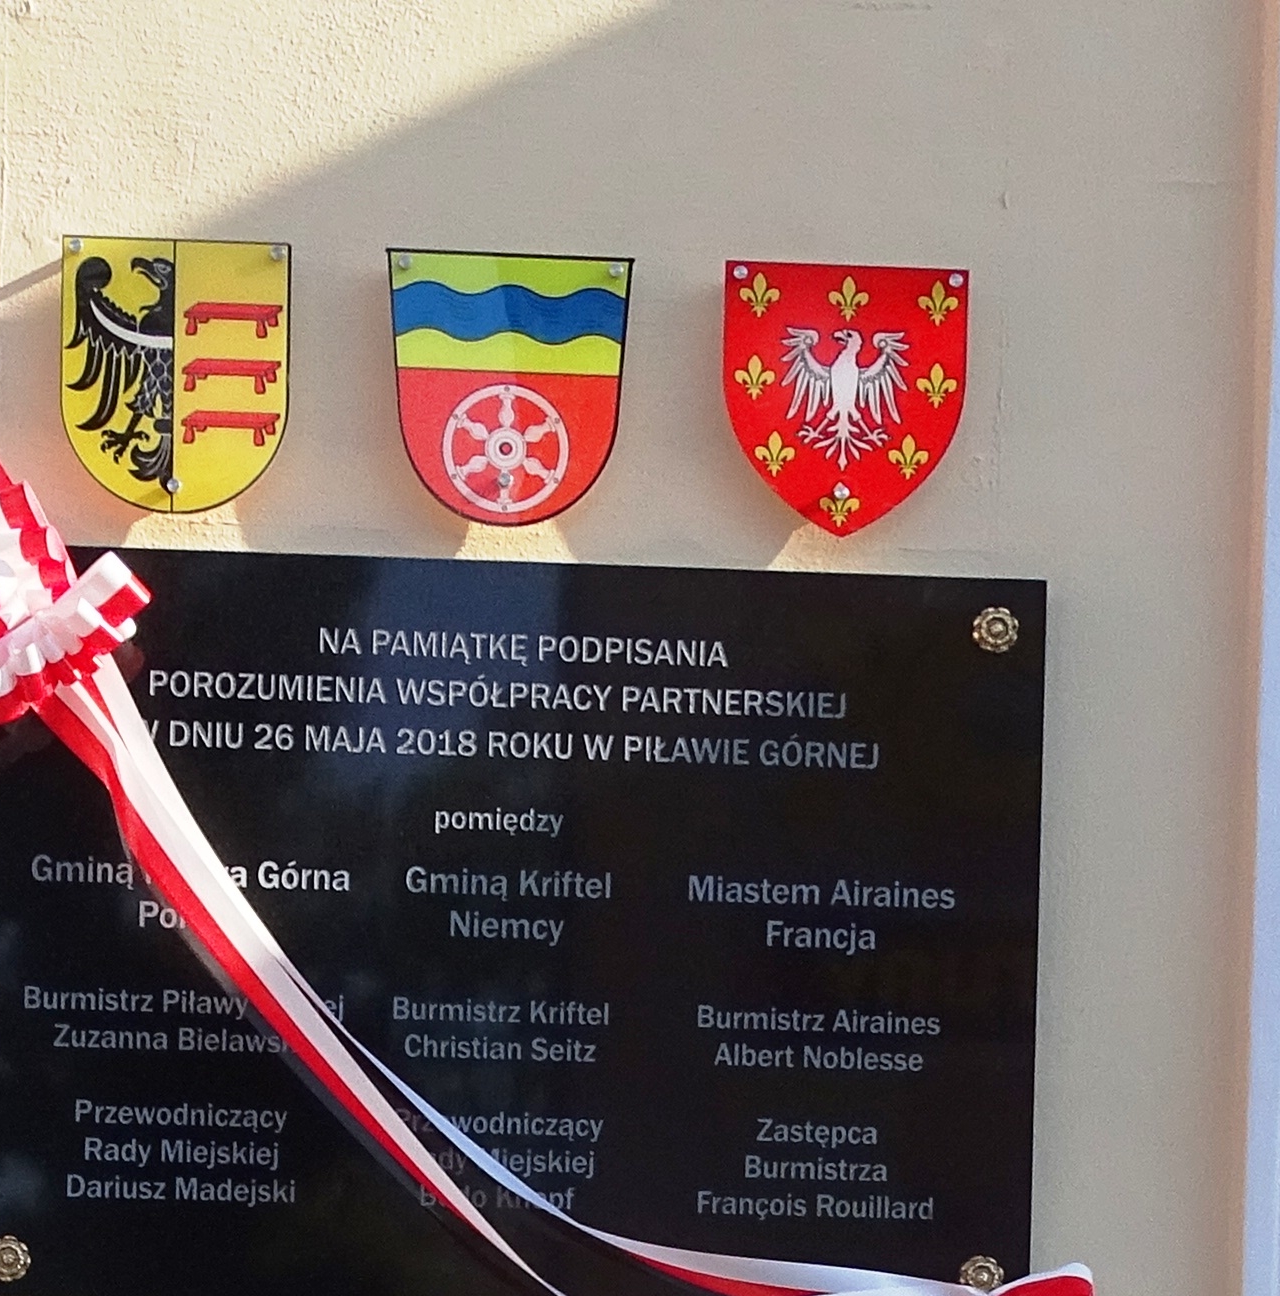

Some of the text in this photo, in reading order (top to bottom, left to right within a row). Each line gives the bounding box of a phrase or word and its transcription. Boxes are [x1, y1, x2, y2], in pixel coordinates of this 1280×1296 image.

[320, 628, 728, 667] NA PAMIĄTKĘ PODPISANIA
[150, 670, 845, 718] POROZUMIENIA WSPÓŁPRACY PARTNERSKIEJ
[170, 720, 243, 748] DNIU
[254, 724, 293, 750] 26
[306, 725, 386, 753] MAJA
[397, 728, 476, 756] 2018
[489, 731, 572, 759] ROKU
[584, 734, 614, 760] W
[625, 735, 749, 764] PIŁAWIE
[760, 734, 879, 769] GÓRNEJ
[435, 807, 563, 837] pomiędzy
[31, 854, 134, 891] Gminą
[258, 861, 349, 891] Górna
[406, 866, 611, 901] Gminą Kriftel
[689, 875, 955, 909] Miastem Airaines
[450, 911, 564, 946] Niemcy
[767, 920, 875, 955] Francja
[24, 986, 248, 1020] Burmistrz Piławy
[393, 997, 609, 1025] Burmistrz Kriftel
[698, 1005, 940, 1035] Burmistrz Airaines
[54, 1024, 286, 1055] Zuzanna Bielaws
[405, 1034, 596, 1062] Christian Seitz
[714, 1043, 923, 1071] Albert Noblesse
[75, 1099, 287, 1133] Przewodniczący
[757, 1119, 877, 1148] Zastępca
[85, 1137, 278, 1170] Rady Miejskiej
[745, 1155, 887, 1181] Burmistrza
[67, 1174, 295, 1207] Dariusz Madejski
[698, 1191, 933, 1220] François Rouillard
